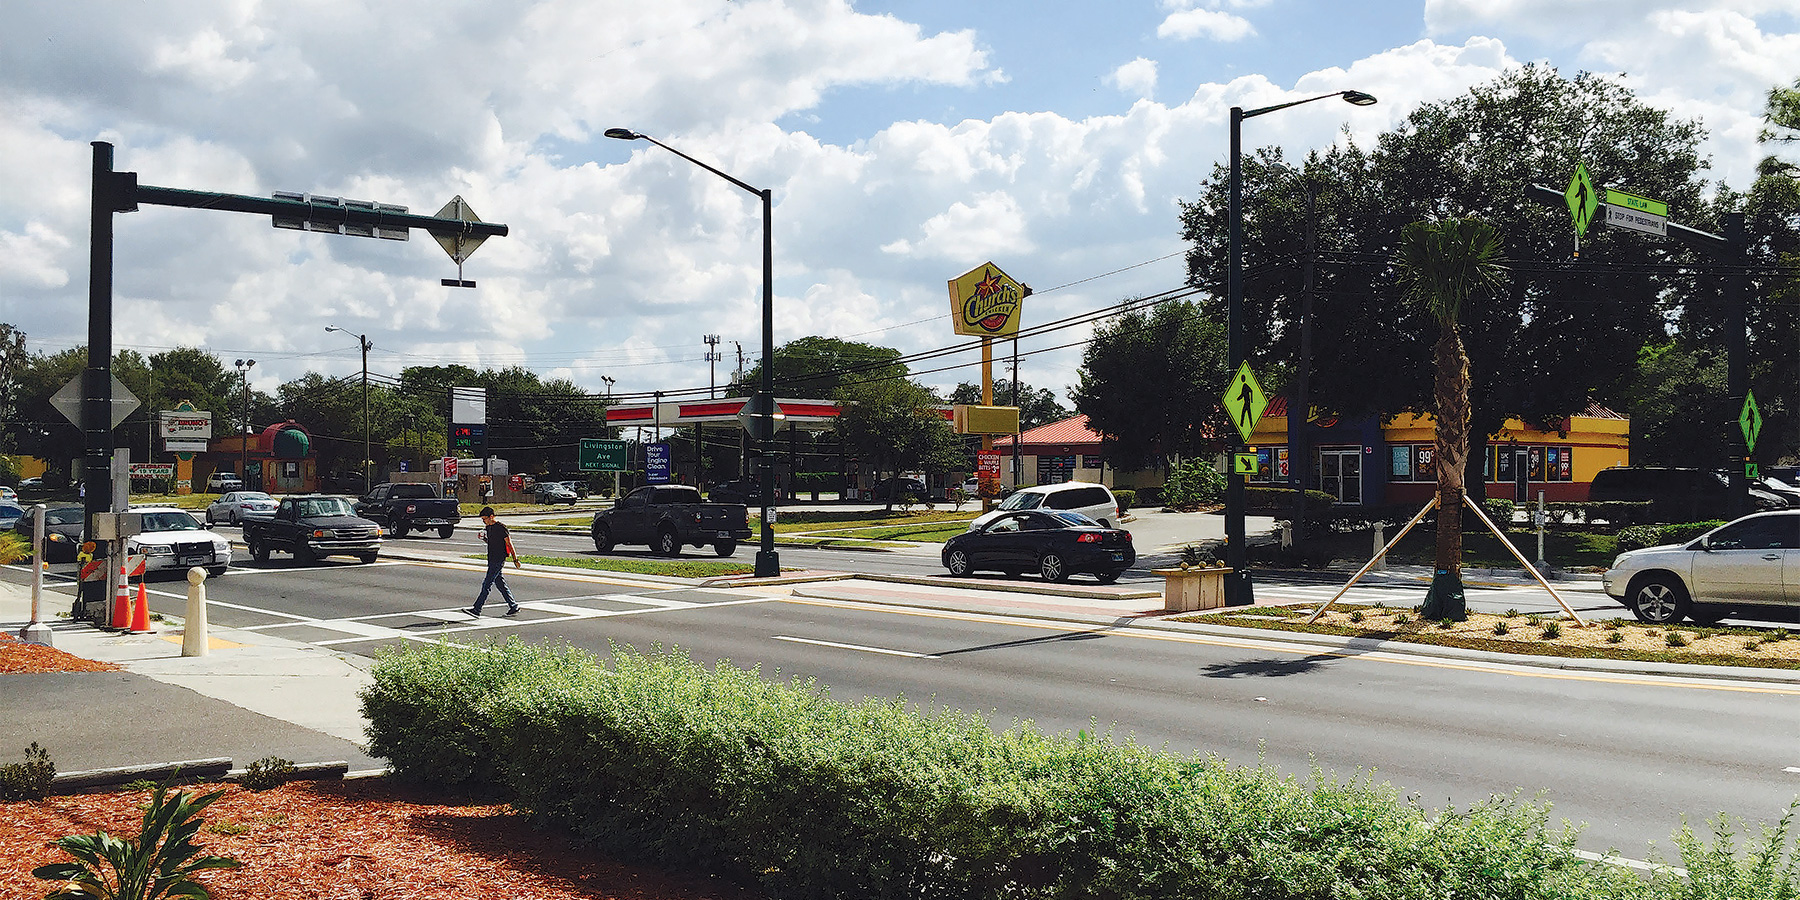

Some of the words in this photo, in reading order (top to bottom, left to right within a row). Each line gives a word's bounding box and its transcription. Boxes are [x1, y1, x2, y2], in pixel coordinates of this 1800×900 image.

[1627, 198, 1639, 207] STATE
[1615, 211, 1625, 220] STOP
[1626, 214, 1634, 222] FOR
[1635, 216, 1659, 229] PEDESTRIANS
[965, 285, 1018, 325] Church's
[584, 442, 624, 451] Livingston
[647, 457, 668, 465] Engine
